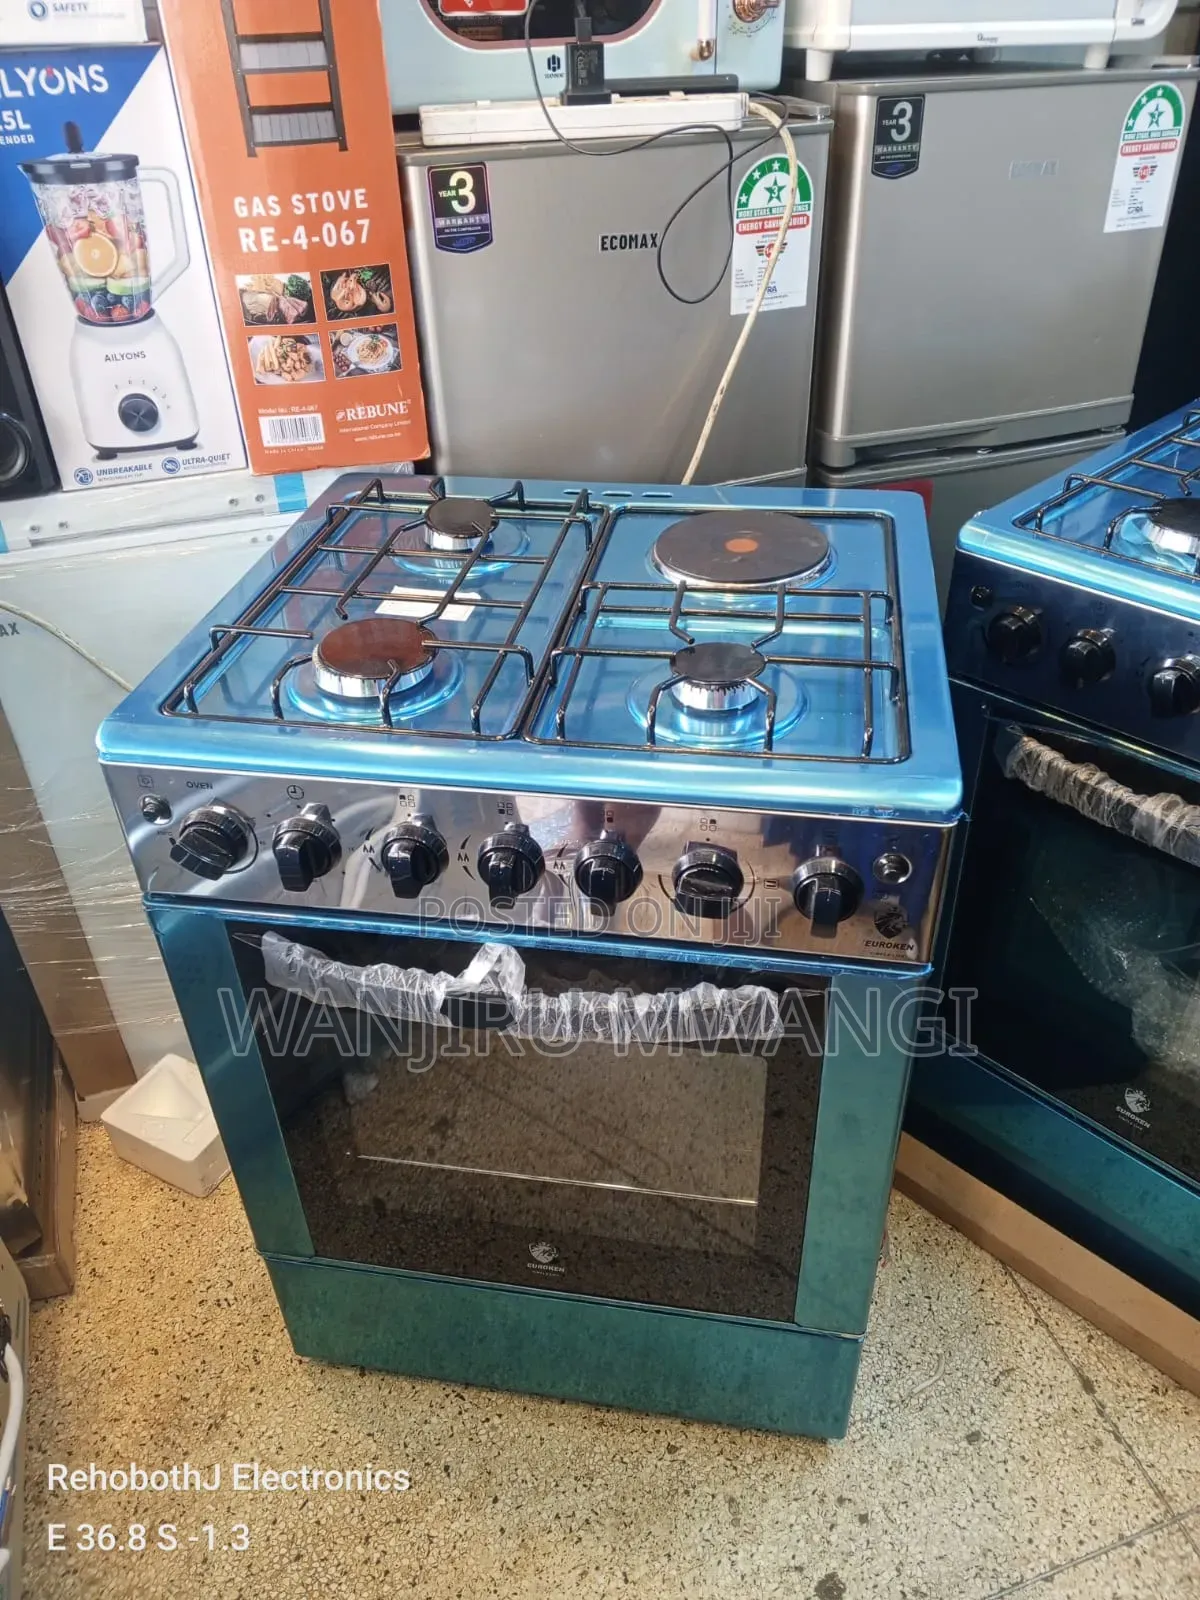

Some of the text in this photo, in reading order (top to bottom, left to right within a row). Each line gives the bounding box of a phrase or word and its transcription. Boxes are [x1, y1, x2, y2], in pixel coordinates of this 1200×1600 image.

[53, 2, 88, 12] SAFETY
[0, 64, 109, 98] LYONS
[891, 101, 912, 142] 3
[438, 190, 456, 198] YEAR
[449, 171, 476, 214] 3
[772, 186, 779, 198] 3
[233, 188, 369, 218] GAS STOVE
[738, 220, 763, 233] ENERGY
[238, 218, 370, 253] RE-4-067
[601, 232, 658, 251] ECOMAX
[104, 350, 146, 363] AILYONS
[346, 401, 409, 421] REBUNE
[182, 453, 231, 466] ULTRA-QUIET
[96, 463, 153, 477] UNBREAKABLE
[186, 780, 213, 790] OVEN
[864, 940, 914, 951] EUROKEN
[527, 1262, 565, 1273] EUROKEN
